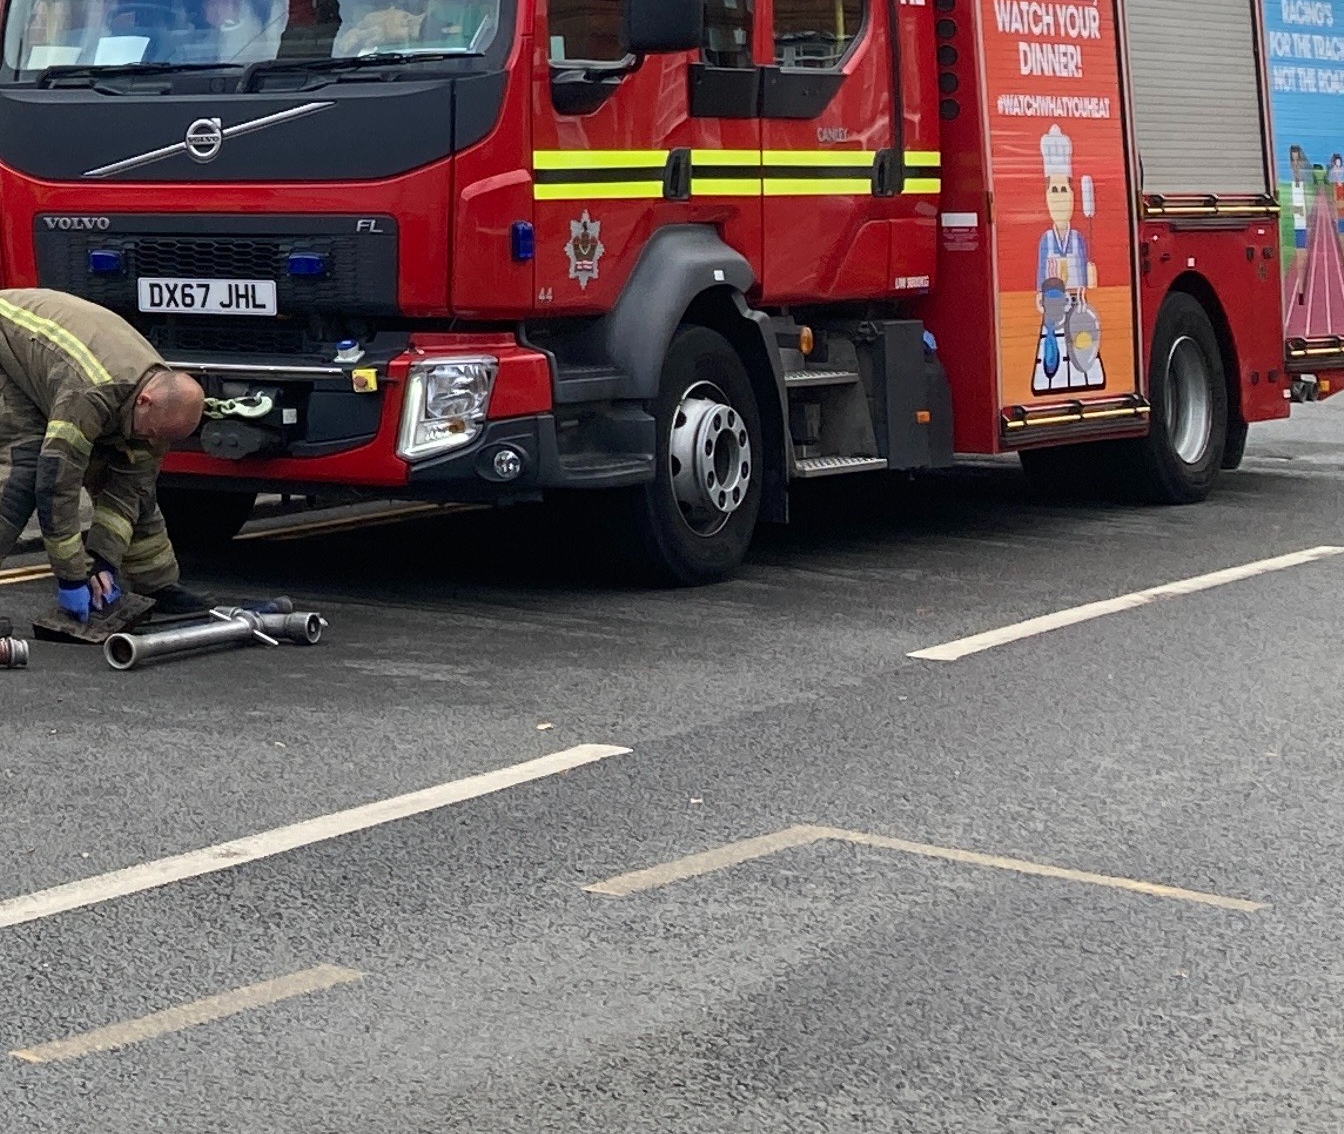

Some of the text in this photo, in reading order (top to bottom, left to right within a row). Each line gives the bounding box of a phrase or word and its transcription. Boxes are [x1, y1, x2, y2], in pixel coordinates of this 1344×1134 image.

[1055, 3, 1101, 39] YOUR
[1018, 42, 1083, 78] DINNER!
[43, 217, 383, 233] VOLVO FL
[149, 283, 266, 309] DX67 JHL
